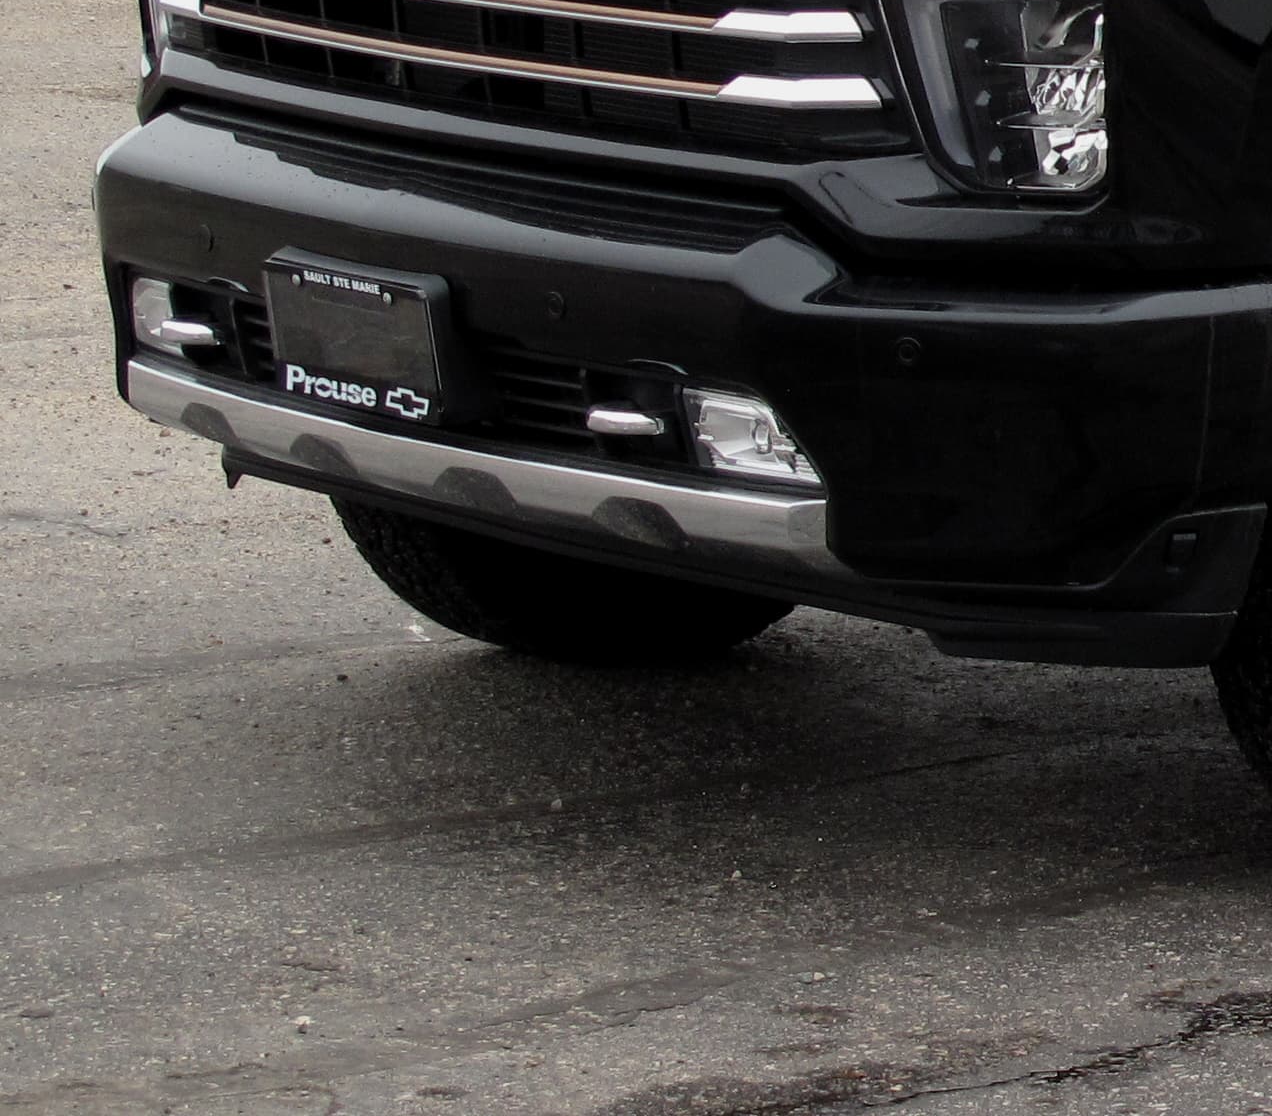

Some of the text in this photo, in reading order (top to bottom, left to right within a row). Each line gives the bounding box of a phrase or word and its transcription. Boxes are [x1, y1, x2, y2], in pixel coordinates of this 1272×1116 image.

[303, 270, 381, 295] SAULT STE MARIE
[285, 363, 377, 407] Prouse
